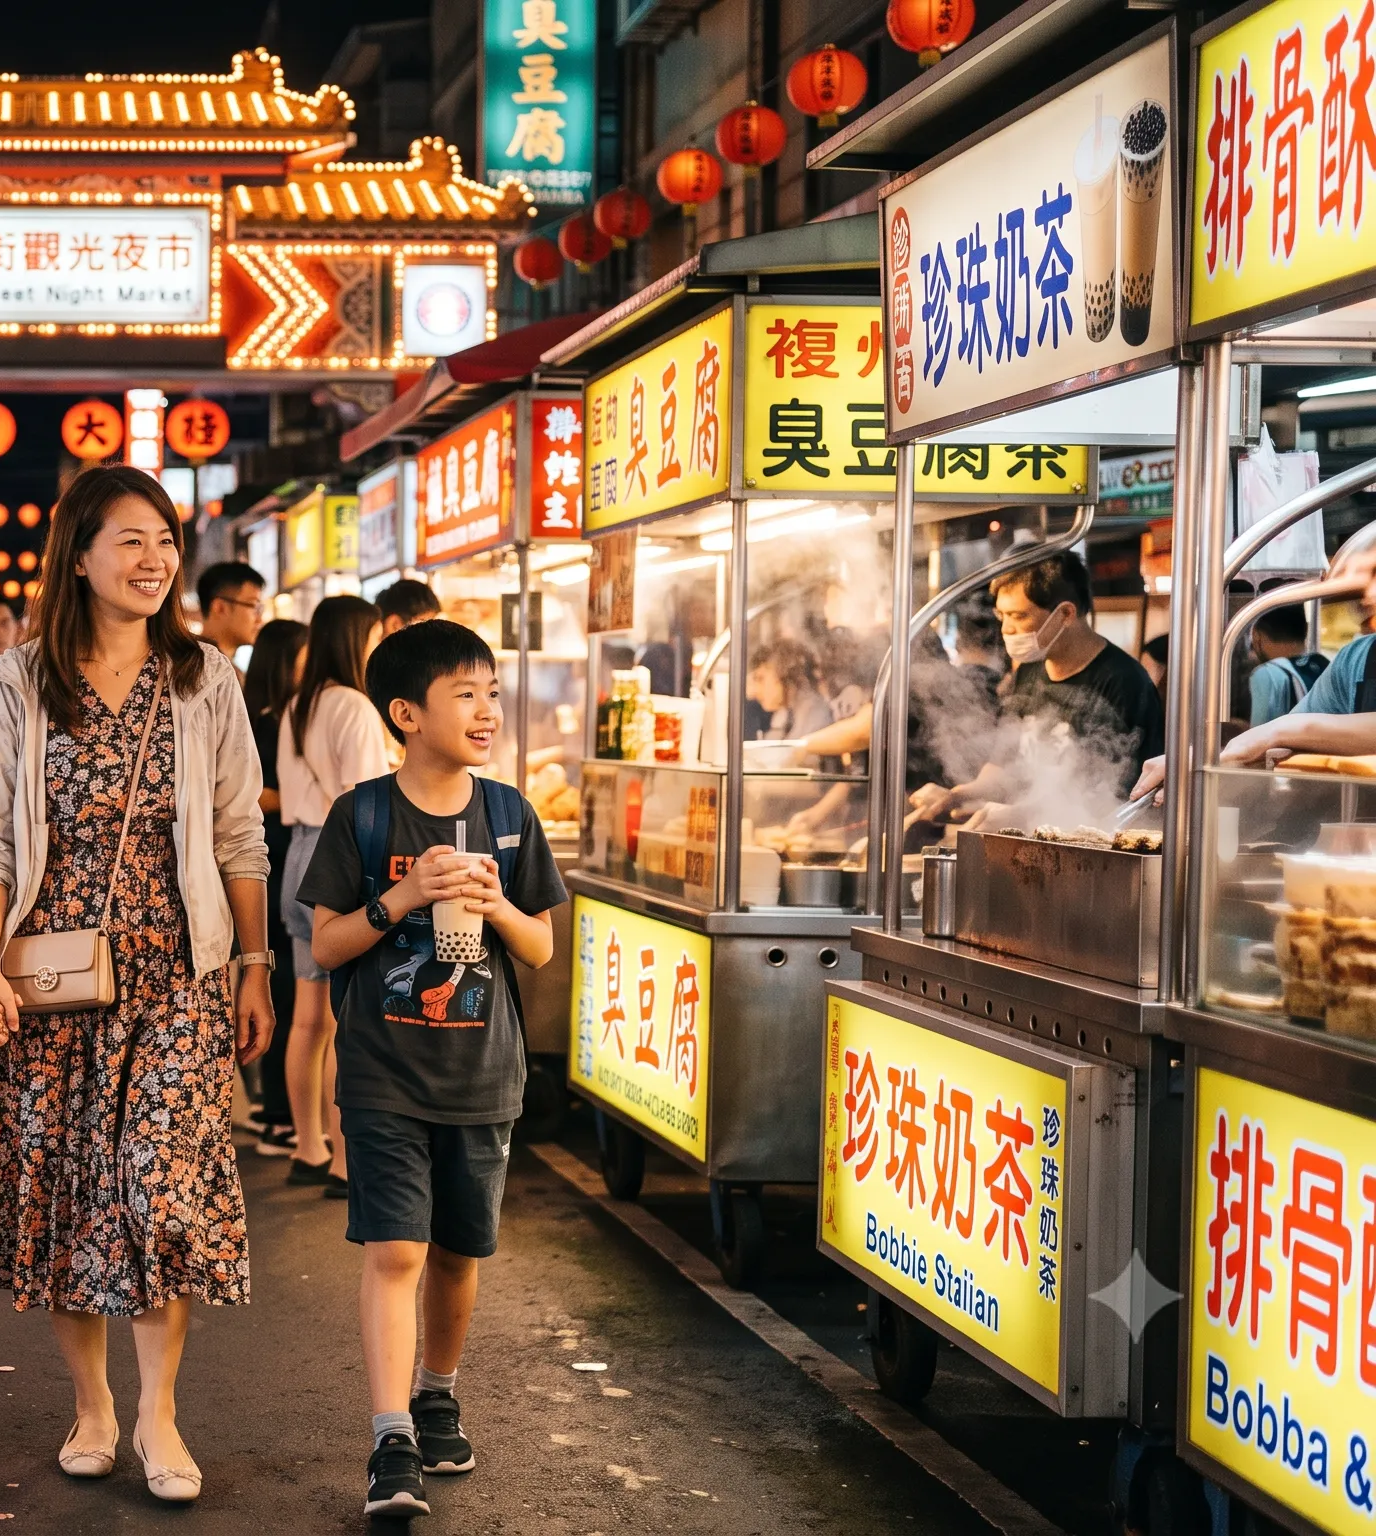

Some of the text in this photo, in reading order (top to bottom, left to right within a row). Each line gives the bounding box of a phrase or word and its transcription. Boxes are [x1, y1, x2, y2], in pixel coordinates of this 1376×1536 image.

[47, 286, 104, 304] Night
[117, 286, 192, 303] Market
[920, 182, 1074, 388] 珍珠奶茶
[77, 411, 106, 446] 大
[624, 340, 720, 502] 臭豆腐
[600, 930, 699, 1099] 臭豆腐
[843, 1051, 1034, 1267] 珍珠奶茶
[1040, 1106, 1062, 1301] 珍珠奶茶
[866, 1212, 927, 1285] Bobbie
[1207, 1113, 1376, 1388] 排骨
[1207, 1353, 1373, 1513] Bobba &
